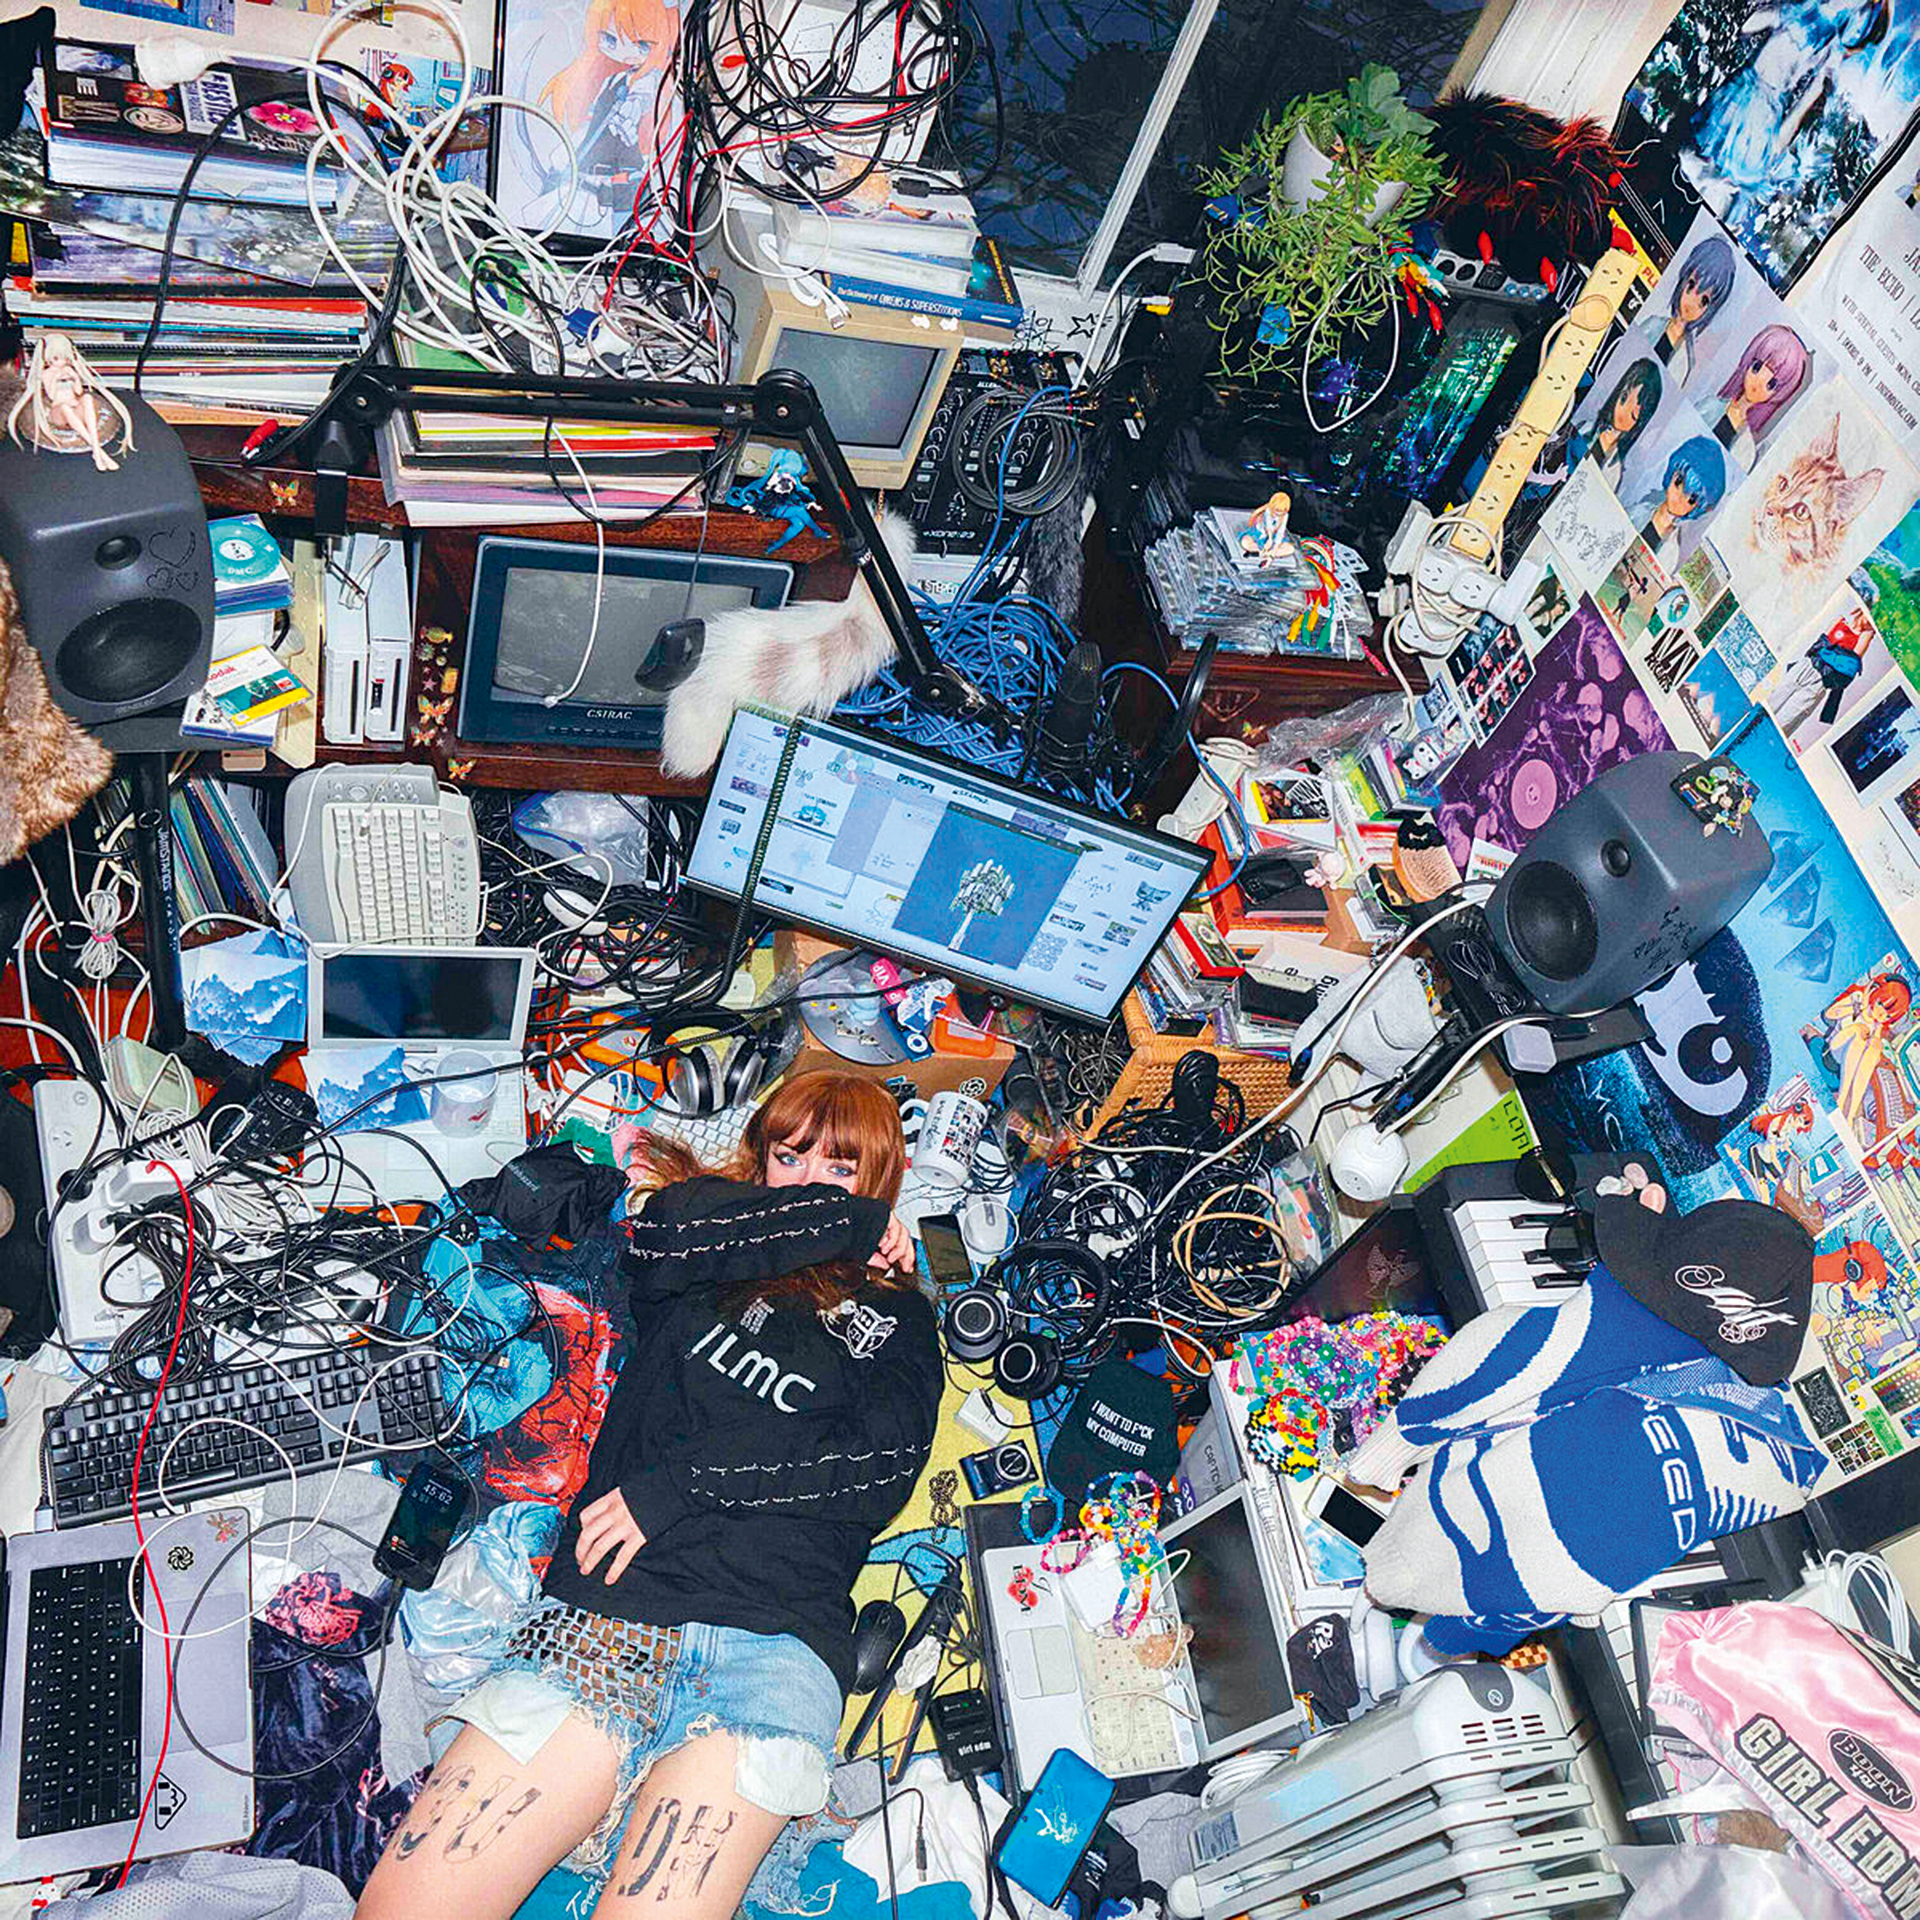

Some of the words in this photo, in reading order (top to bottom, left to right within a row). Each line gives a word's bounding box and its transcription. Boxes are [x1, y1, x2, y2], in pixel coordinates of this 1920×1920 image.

[586, 708, 633, 720] CSIRAC
[1096, 1402, 1122, 1426] WANT
[1119, 1415, 1133, 1431] TO
[1086, 1417, 1100, 1434] MY
[1098, 1425, 1147, 1457] COMPUTER
[1734, 1712, 1849, 1830] GIRL
